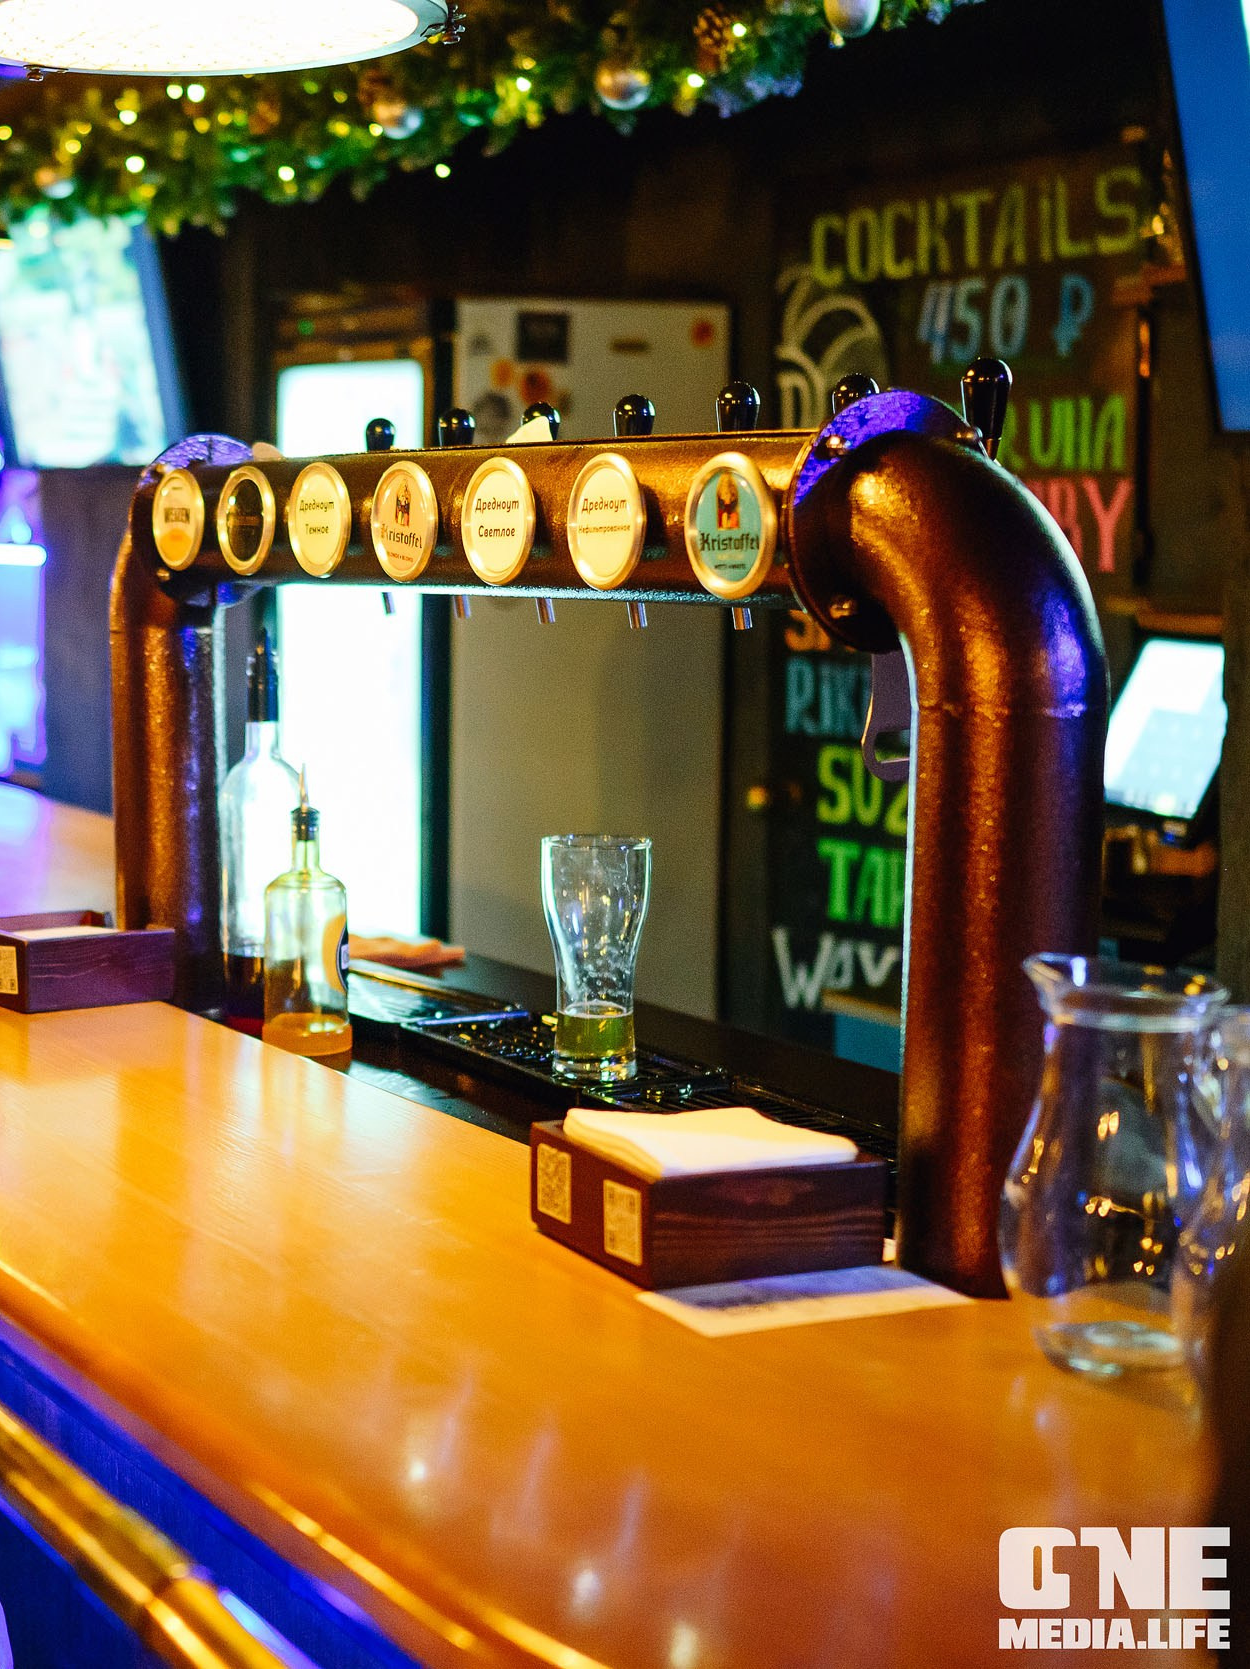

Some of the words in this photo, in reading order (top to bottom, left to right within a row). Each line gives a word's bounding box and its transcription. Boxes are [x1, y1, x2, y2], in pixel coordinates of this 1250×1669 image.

[810, 166, 1145, 288] COCKTAILS
[917, 274, 1031, 363] 450
[299, 499, 335, 514] Дредноут
[475, 497, 520, 514] Дредноут
[581, 496, 627, 514] Дредноут
[305, 523, 329, 535] Темное
[380, 523, 423, 549] Kristoffel
[478, 525, 516, 538] Светлое
[699, 531, 760, 552] Kristoffel
